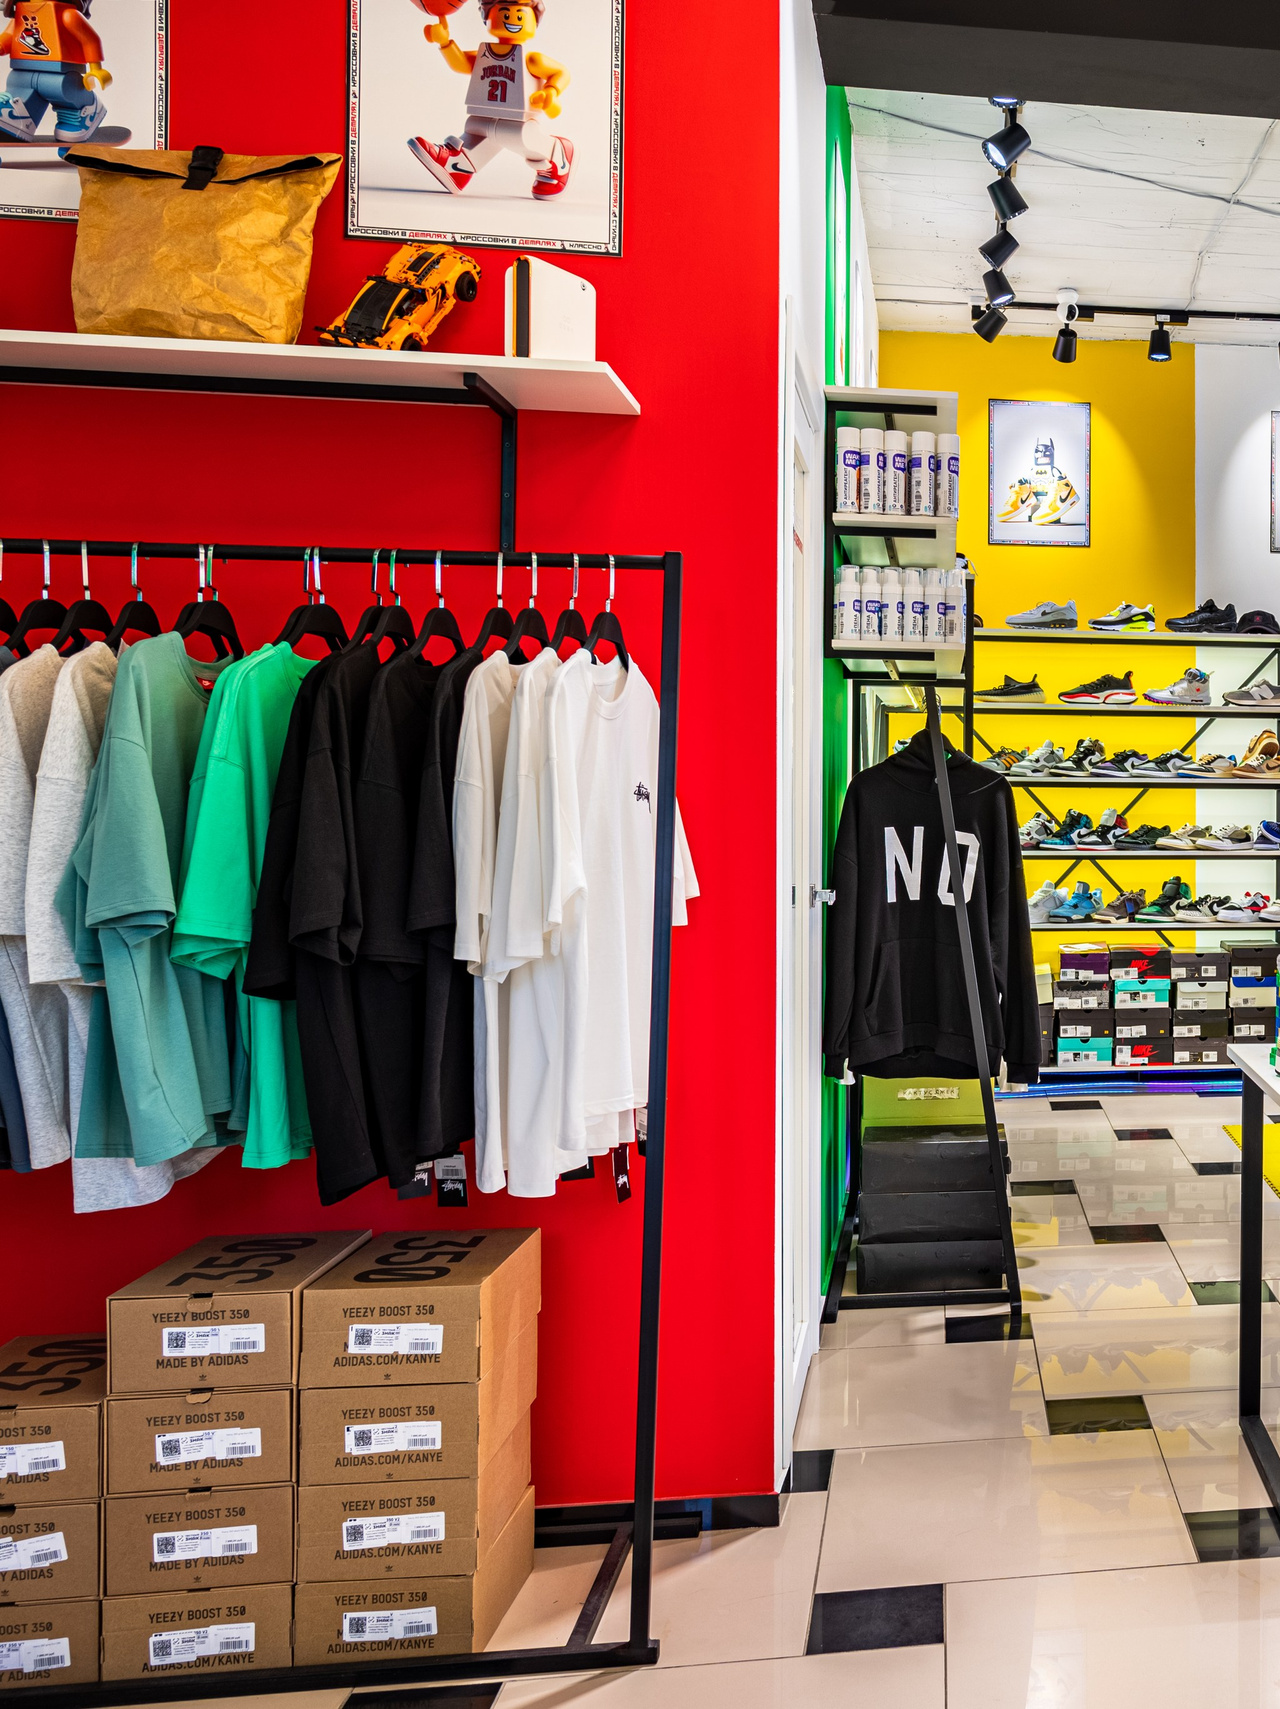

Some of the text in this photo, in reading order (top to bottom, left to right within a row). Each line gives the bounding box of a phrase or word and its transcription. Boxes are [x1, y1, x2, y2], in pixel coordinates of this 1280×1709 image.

[480, 64, 516, 83] JORDAN
[488, 80, 508, 103] 21
[349, 228, 400, 237] КРОССОВКИ
[460, 235, 510, 244] КРОССОВКИ
[1130, 960, 1149, 970] NIKE
[1132, 1045, 1154, 1056] NIKE
[165, 1237, 318, 1288] 350
[353, 1235, 487, 1283] 350
[152, 1309, 250, 1324] YEEZY BOOST 350
[342, 1304, 435, 1319] YEEZY BOOST 350
[156, 1355, 249, 1369] MADE BY ADIDAS
[333, 1353, 441, 1368] ADIDAS.COM/KANYE
[146, 1411, 245, 1427] YEEZY BOOST 350
[342, 1406, 435, 1420] YEEZY BOOST 350
[30, 1426, 52, 1436] 350
[150, 1457, 244, 1473] MADE BY ADIDAS
[334, 1452, 443, 1468] ADIDAS.COM/KANYE
[6, 1472, 50, 1485] ADIDAS
[342, 1496, 435, 1512] YEEZY BOOST 350
[145, 1506, 246, 1524] YEEZY BOOST 350
[1, 1522, 56, 1535] OOST 350
[334, 1544, 443, 1561] ADIDAS.COM/KANYE
[150, 1555, 245, 1572] MADE BY ADIDAS
[10, 1569, 54, 1582] ADIDAS
[335, 1592, 428, 1606] YEEZY BOOST 350
[148, 1606, 246, 1624] YEEZY BOOST 350
[0, 1622, 53, 1635] OOST 350
[327, 1639, 435, 1654] ADIDAS.COM/KANYE
[142, 1654, 255, 1673] ADIDAS.COM/KANYE
[8, 1669, 51, 1682] ADIDAS
